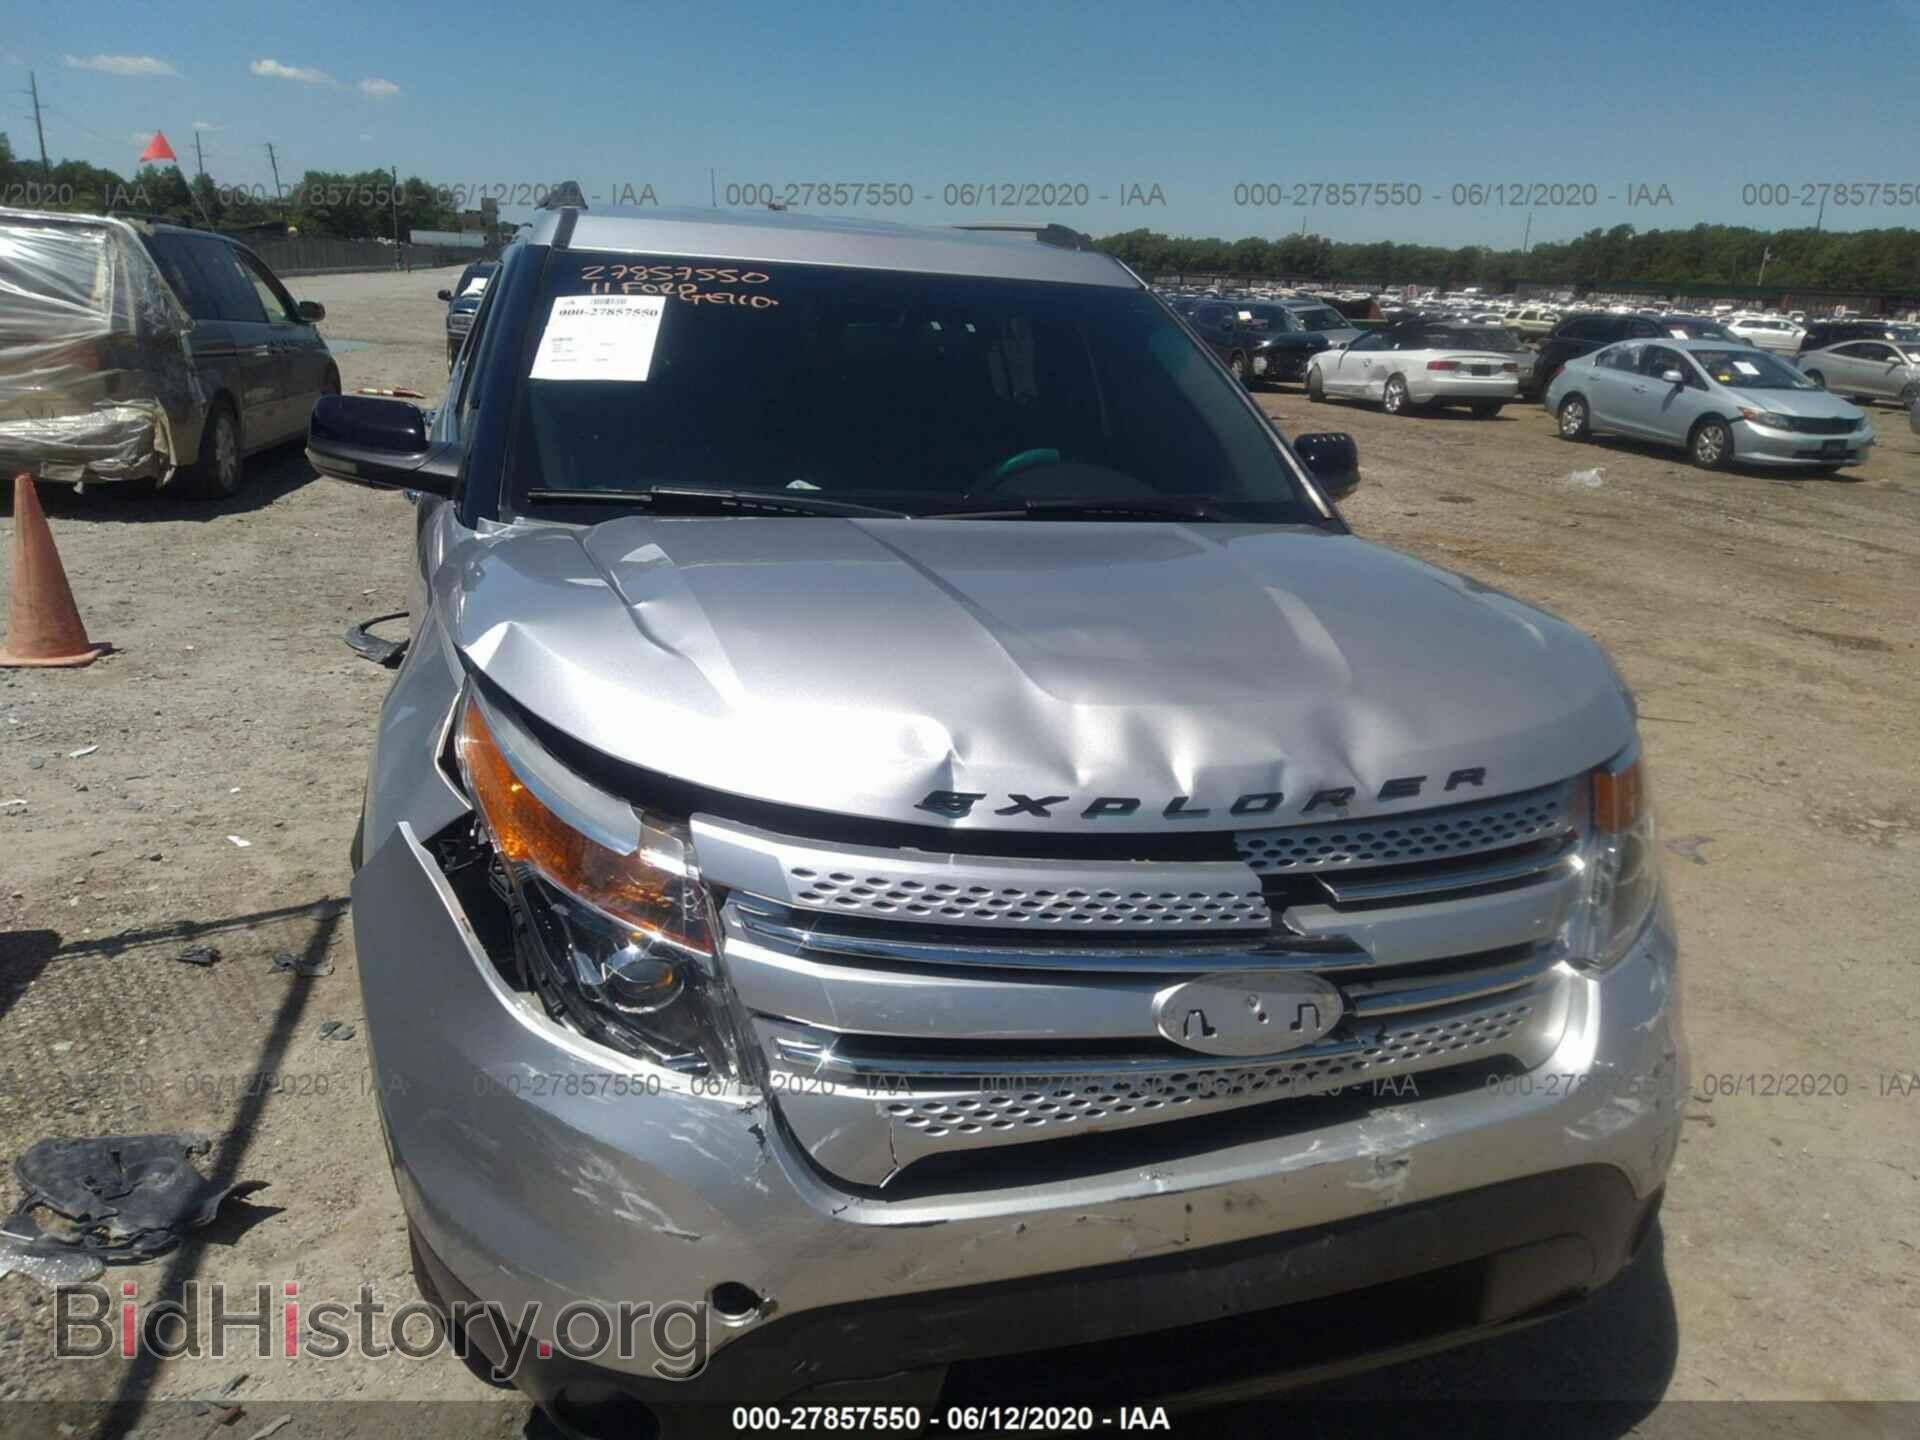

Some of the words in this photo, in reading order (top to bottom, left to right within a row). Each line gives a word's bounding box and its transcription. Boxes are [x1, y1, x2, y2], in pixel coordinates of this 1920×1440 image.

[581, 264, 769, 283] 27857550
[559, 307, 659, 318] 000-27857550
[914, 766, 1487, 819] EXPLORER
